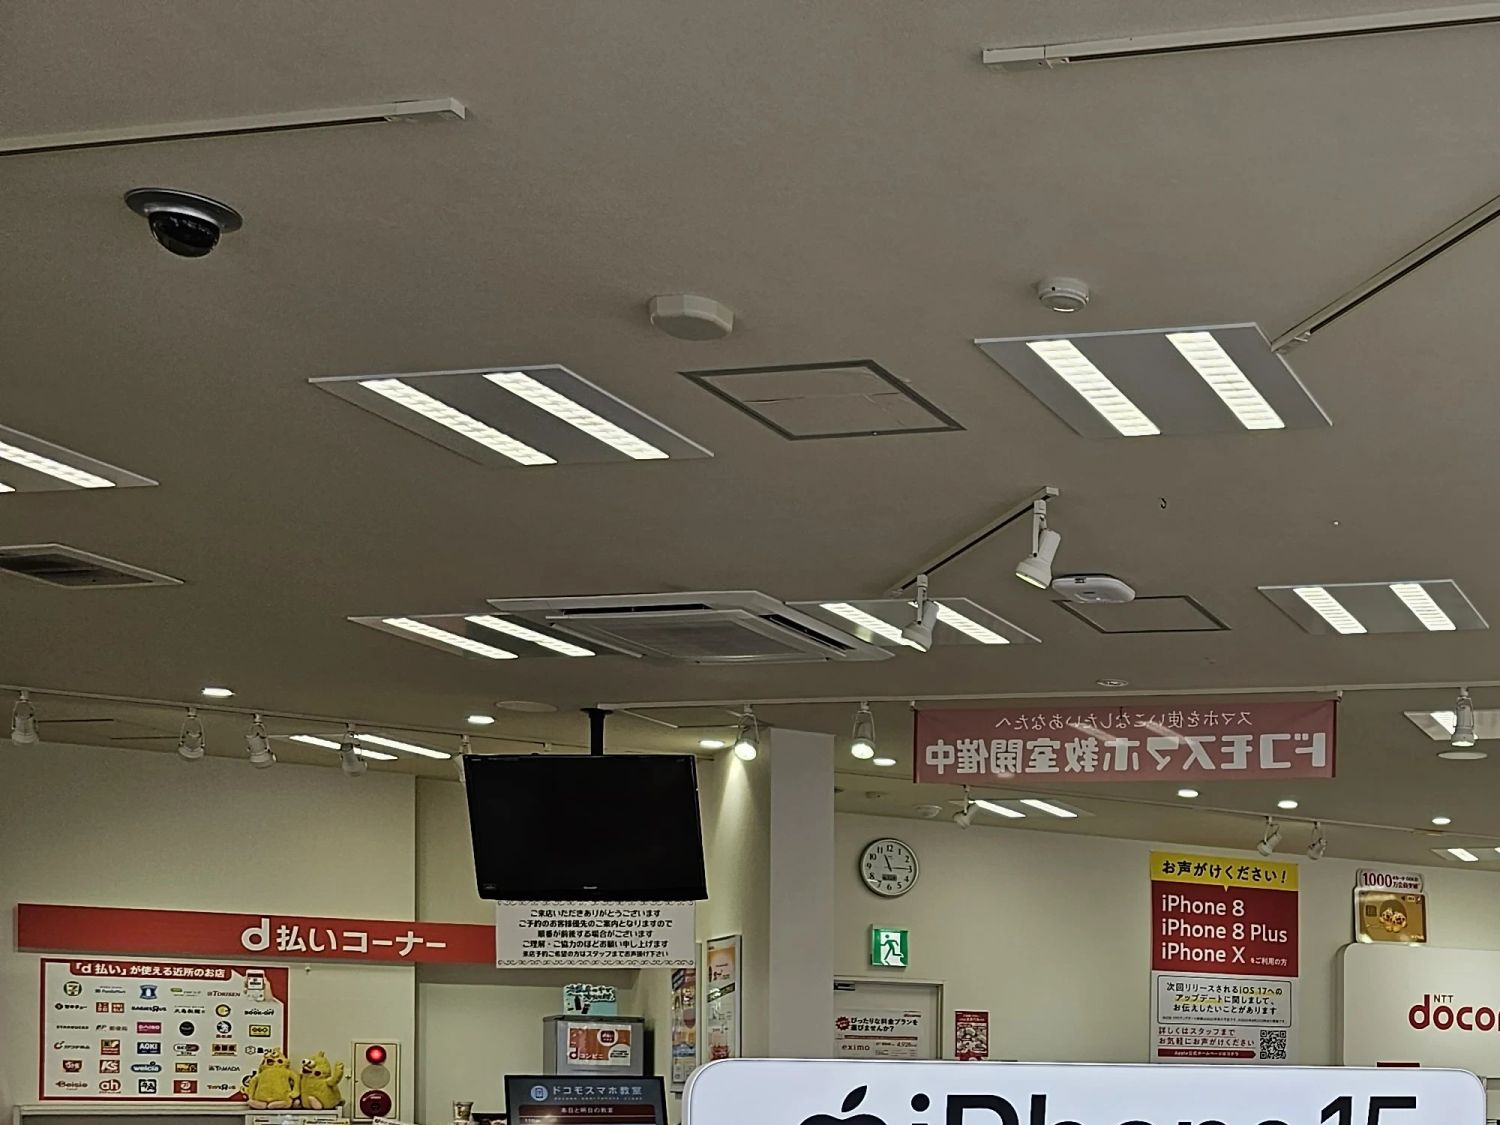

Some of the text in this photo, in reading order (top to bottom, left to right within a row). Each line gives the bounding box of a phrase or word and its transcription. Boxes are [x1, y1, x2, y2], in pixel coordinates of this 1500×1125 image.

[1161, 860, 1287, 884] お声がけください!
[1161, 895, 1245, 917] iPhone 8
[531, 909, 661, 918] ご来店いただきありがとうございます
[518, 919, 673, 928] ご予約のお客様優先のご案内となりますので
[537, 930, 653, 938] 順番が前後する場合がございます
[1161, 918, 1288, 943] iPhone 8 Plus
[240, 918, 447, 958] d払いコーナー
[1161, 942, 1227, 962] iPhone
[1231, 946, 1246, 964] X
[1174, 994, 1276, 1006] アップデートに関しまして、
[1433, 995, 1454, 1003] NTT
[1173, 1004, 1277, 1015] お伝えしたいことがあります
[1158, 1026, 1236, 1036] 詳しくはスタッフまで
[1158, 1037, 1255, 1047] お気軽にお声がけください
[553, 1085, 643, 1095] ドコモスマホ教室
